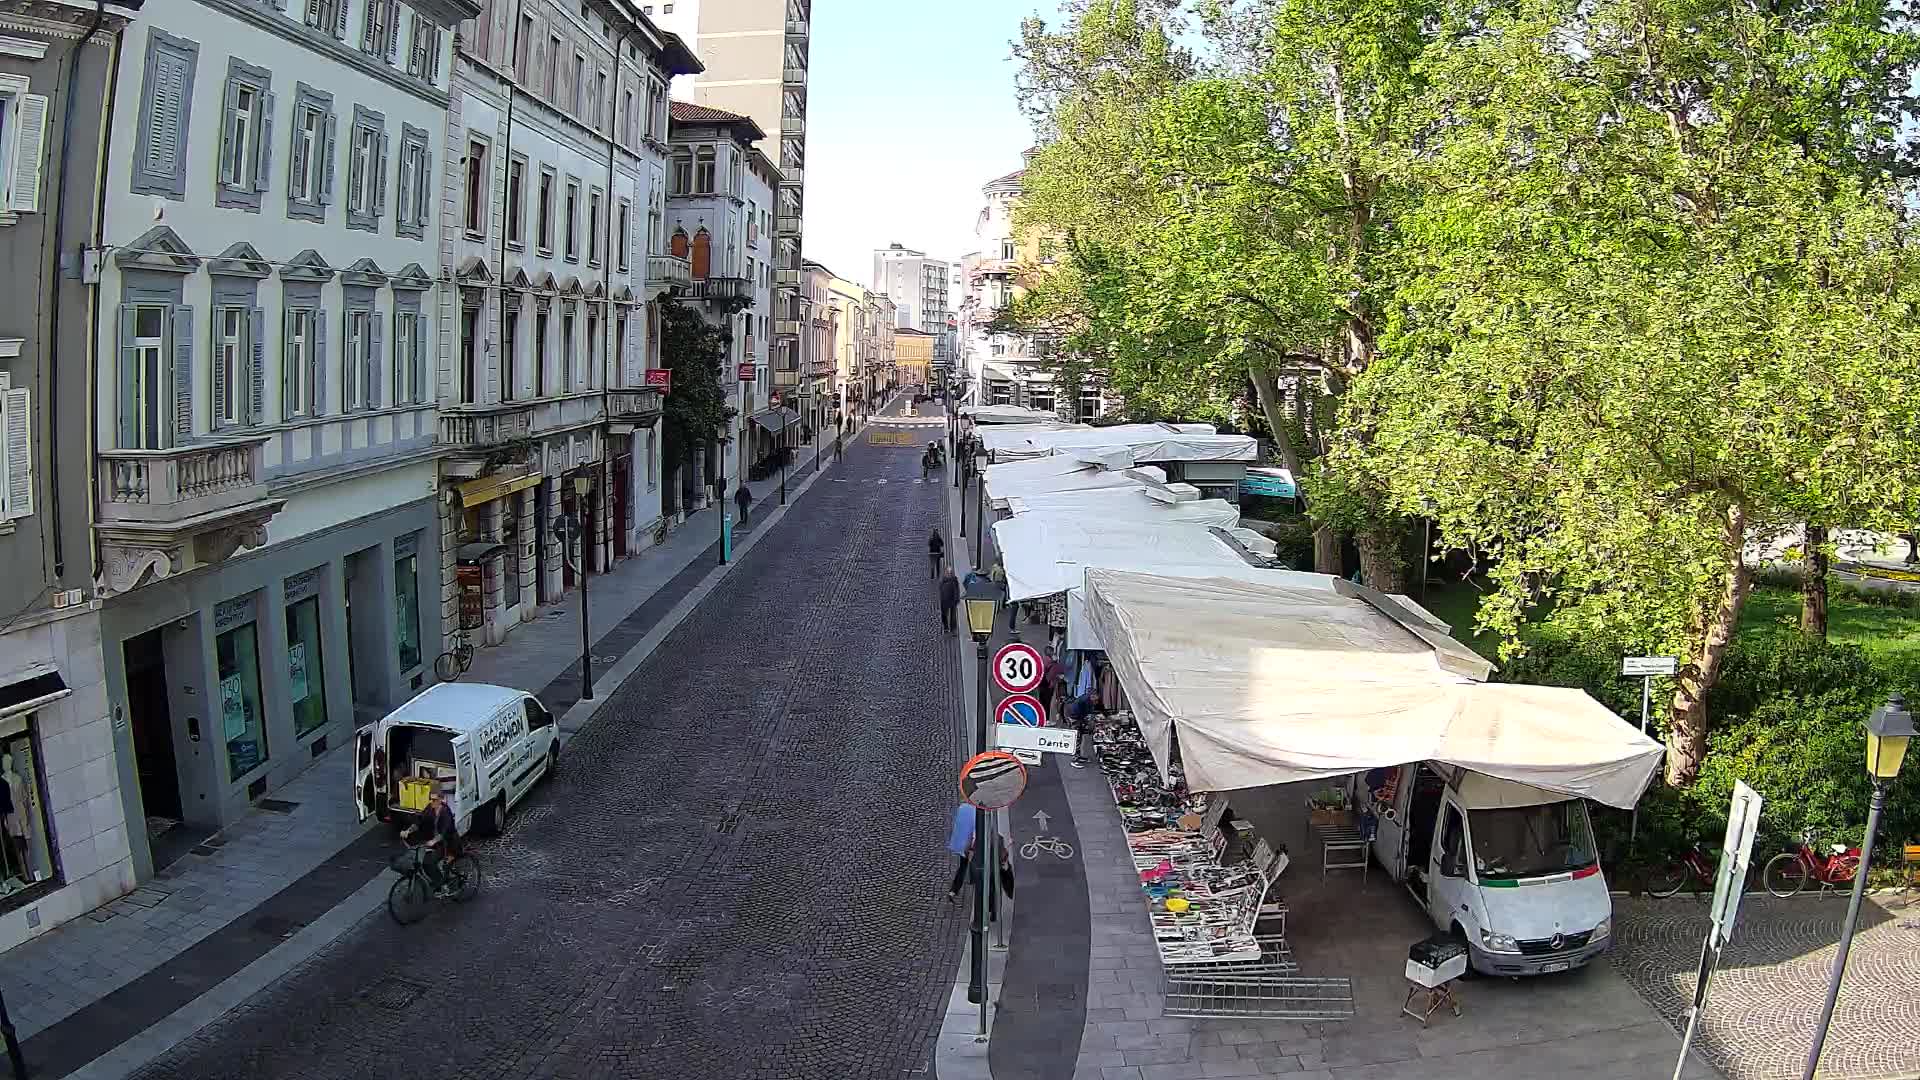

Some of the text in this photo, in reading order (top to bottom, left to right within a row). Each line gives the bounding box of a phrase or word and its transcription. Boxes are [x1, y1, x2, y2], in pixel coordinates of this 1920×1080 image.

[1005, 658, 1032, 680] 30
[480, 716, 524, 763] MOSCHION
[1038, 737, 1070, 749] Dante
